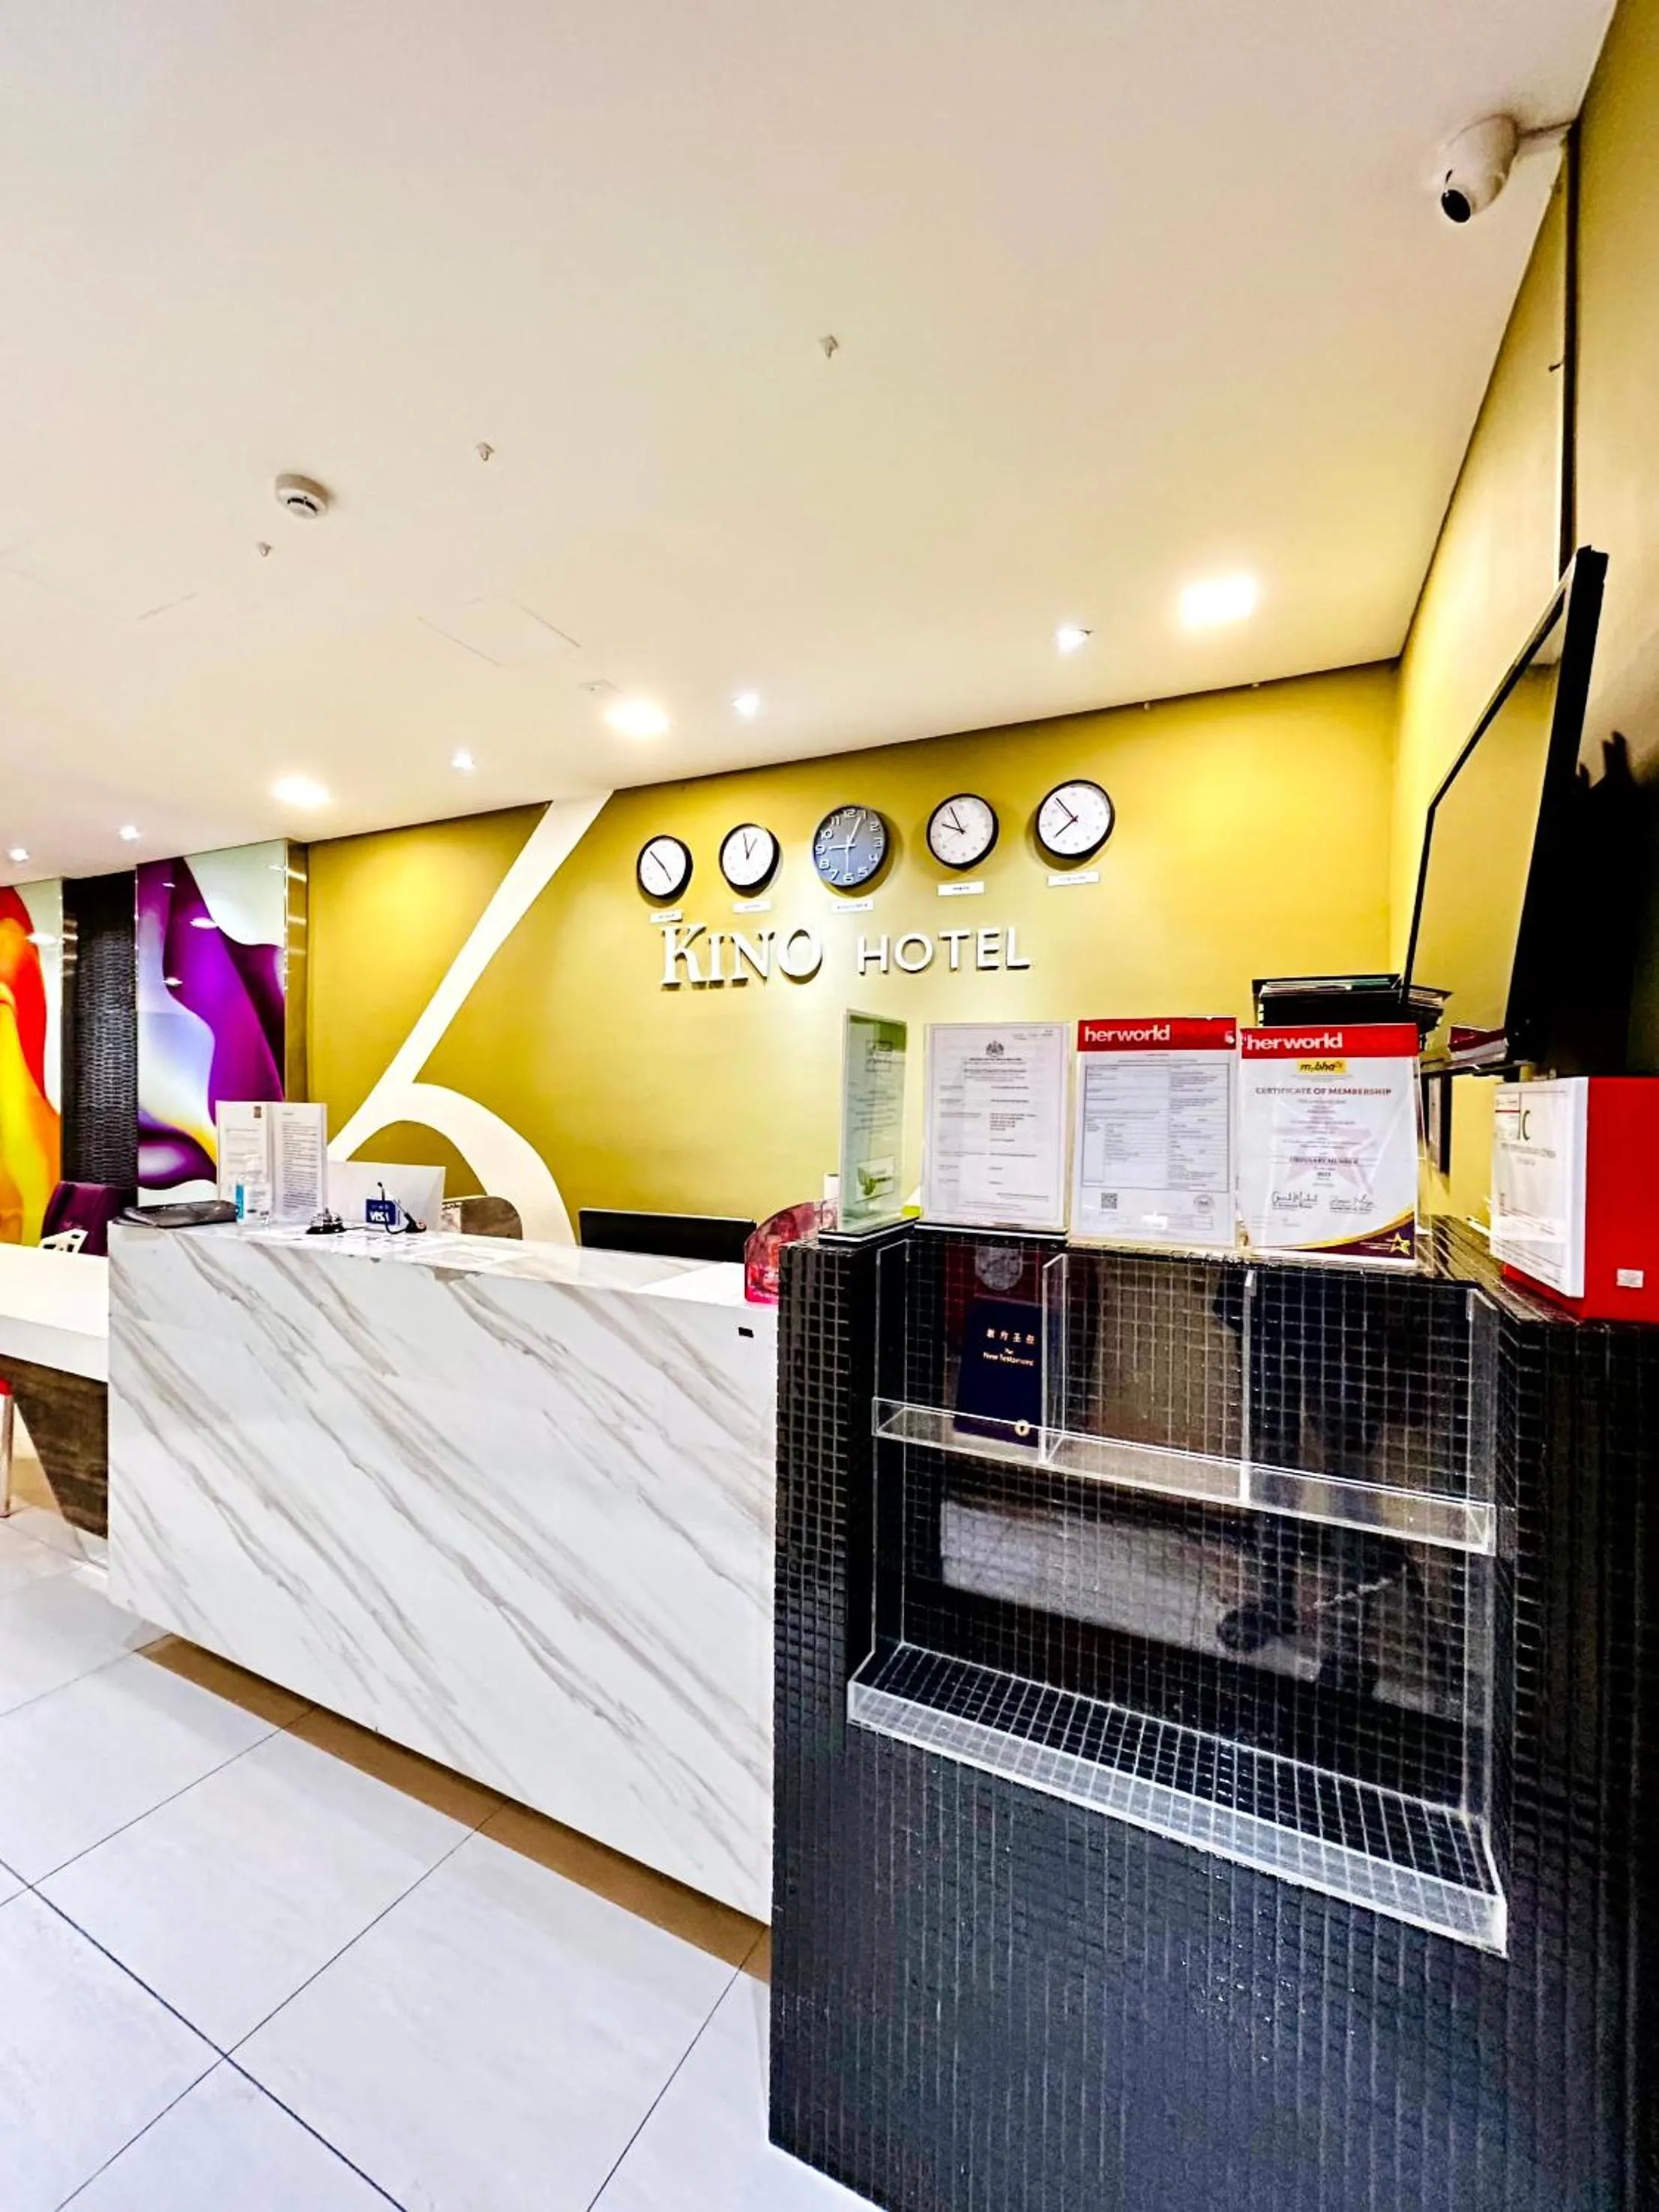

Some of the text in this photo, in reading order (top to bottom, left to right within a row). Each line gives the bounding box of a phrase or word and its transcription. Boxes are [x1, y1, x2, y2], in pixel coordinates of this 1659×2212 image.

[843, 809, 857, 819] 12
[831, 816, 840, 826] 11
[870, 822, 881, 831] 2
[821, 828, 833, 840] 10
[873, 837, 882, 848] 3
[815, 844, 826, 855] 9
[869, 853, 879, 863] 4
[819, 858, 830, 870] 8
[831, 869, 840, 881] 7
[843, 872, 854, 883] 6
[858, 867, 869, 877] 5
[660, 922, 1032, 985] KINO HOTEL
[1084, 1024, 1171, 1042] herworld
[1247, 1032, 1343, 1051] herworld
[1255, 1086, 1392, 1096] CERTIFICATE OF MEMBERSHIP
[984, 1351, 999, 1360] New
